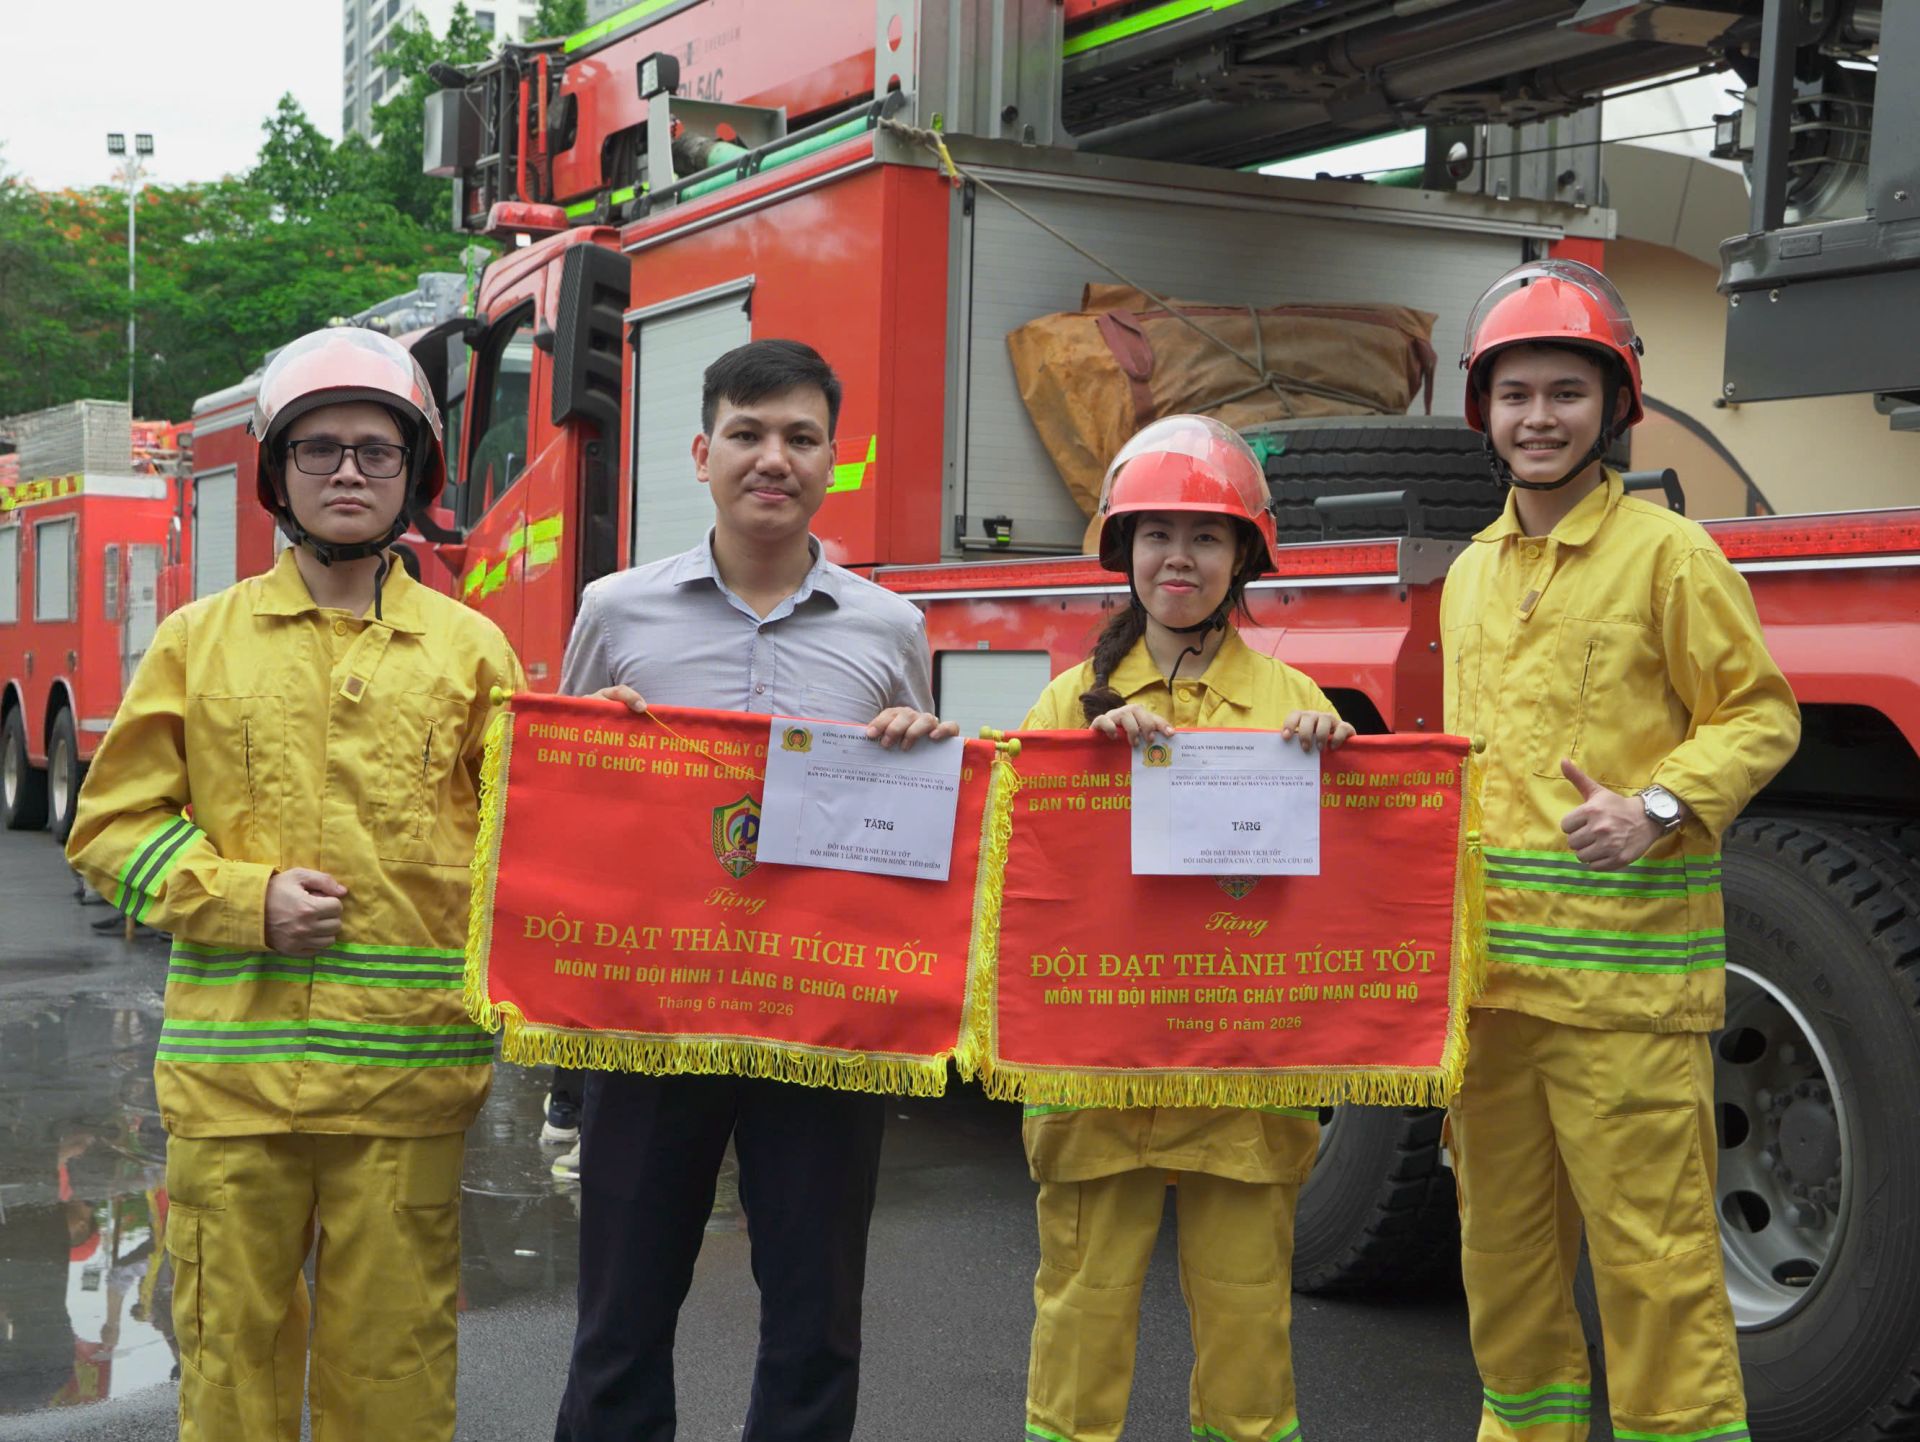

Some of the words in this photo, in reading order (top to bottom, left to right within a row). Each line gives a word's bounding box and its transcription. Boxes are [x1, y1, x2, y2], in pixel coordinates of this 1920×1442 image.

[529, 723, 579, 742] PHÒNG
[583, 725, 624, 746] CẢNH
[628, 732, 655, 750] SÁT
[660, 736, 709, 754] PHÒNG
[713, 739, 750, 757] CHÁY
[537, 748, 571, 765] BAN
[577, 749, 597, 768] TỔ
[601, 754, 646, 773] CHỨC
[652, 758, 678, 778] HỘI
[684, 762, 709, 778] THI
[713, 763, 755, 781] CHỮA
[1019, 772, 1067, 789] PHÒNG
[1071, 770, 1110, 787] CẢNH
[1114, 772, 1132, 787] SÁ
[1322, 772, 1331, 785] &
[1336, 770, 1365, 787] CỨU
[1369, 774, 1399, 790] NẠN
[1403, 770, 1431, 786] CỨU
[1435, 769, 1455, 789] HỘ
[1029, 798, 1062, 811] BAN
[1067, 792, 1087, 810] TỔ
[1320, 792, 1340, 808] ỨU
[1345, 794, 1380, 811] NẠN
[1384, 792, 1417, 808] CỨU
[1421, 792, 1444, 811] HỘ
[704, 887, 767, 915] Tặng
[1205, 911, 1269, 938] Tặng
[523, 911, 584, 948] ĐỘI
[594, 922, 663, 955] ĐẠT
[671, 921, 782, 957] THÀNH
[790, 931, 867, 968] TÍCH
[875, 940, 938, 975] TỐT
[1030, 947, 1088, 983] ĐỘI
[1098, 954, 1164, 983] ĐẠT
[1174, 947, 1287, 976] THÀNH
[1295, 944, 1364, 974] TÍCH
[1373, 939, 1435, 973] TỐT
[554, 958, 597, 979] MÔN
[603, 964, 631, 981] THI
[636, 965, 666, 986] ĐỘI
[670, 966, 711, 984] HÌNH
[716, 969, 724, 984] 1
[731, 967, 777, 989] LĂNG
[783, 976, 794, 991] B
[799, 978, 846, 999] CHỮA
[852, 984, 900, 1004] CHÁY
[1044, 987, 1082, 1004] MÔN
[1088, 989, 1113, 1005] THI
[1118, 987, 1145, 1008] ĐỘI
[1151, 986, 1190, 1004] HÌNH
[1195, 986, 1237, 1004] CHỮA
[1243, 985, 1284, 1004] CHÁY
[1289, 983, 1318, 1001] CỨU
[1322, 984, 1354, 1003] NẠN
[1359, 980, 1391, 999] CỨU
[1396, 981, 1419, 1004] HỘ
[657, 996, 703, 1011] Tháng
[707, 997, 716, 1009] 6
[720, 998, 753, 1011] năm
[758, 1000, 794, 1016] 2026
[1167, 1018, 1214, 1033] Tháng
[1219, 1018, 1228, 1030] 6
[1233, 1018, 1265, 1030] năm
[1270, 1016, 1302, 1030] 2026
